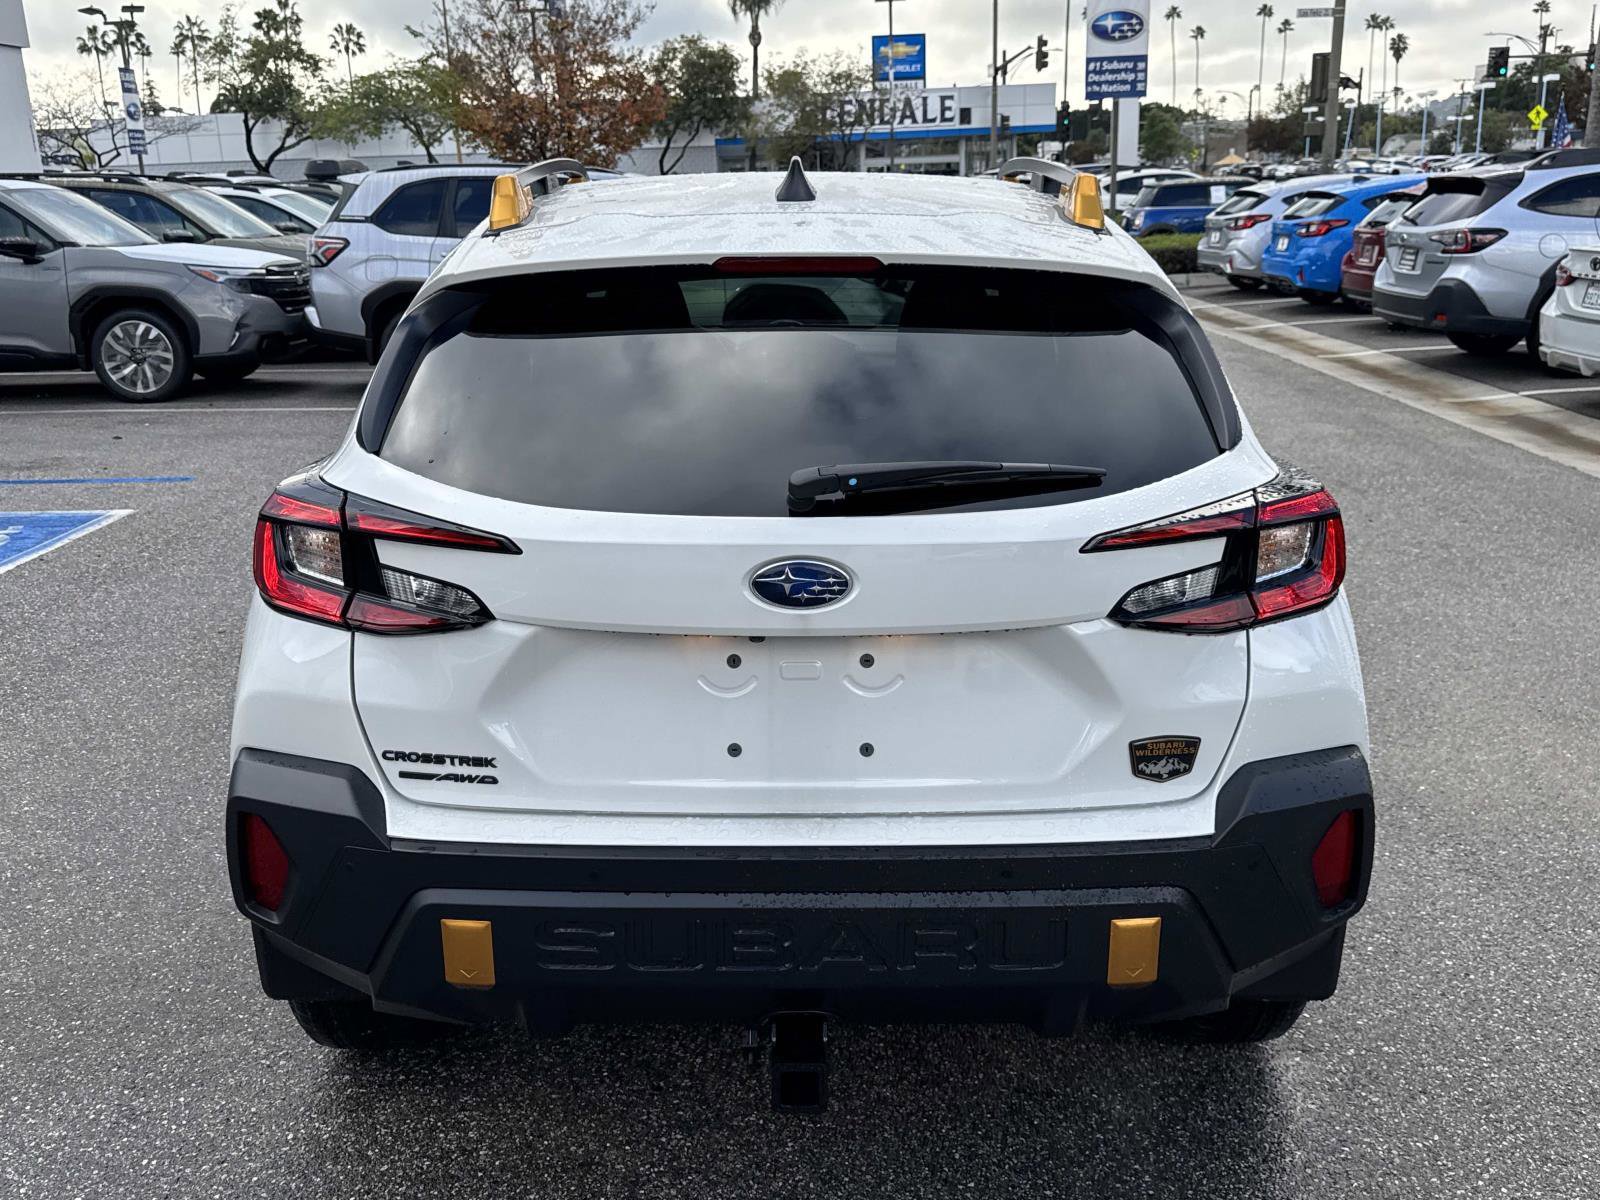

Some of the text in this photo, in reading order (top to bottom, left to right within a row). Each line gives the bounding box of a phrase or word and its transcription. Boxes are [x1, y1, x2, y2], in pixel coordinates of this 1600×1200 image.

[1088, 61, 1100, 71] #1
[1102, 60, 1134, 70] Subaru
[1088, 71, 1136, 82] Dealership
[1101, 83, 1131, 92] Nation
[822, 94, 956, 127] ENDALE
[1147, 741, 1186, 750] SUBARU
[1135, 747, 1196, 756] WILDERNESS
[381, 750, 498, 768] CROSSTREK
[436, 773, 499, 784] AWD
[534, 919, 1068, 971] SUBARU
